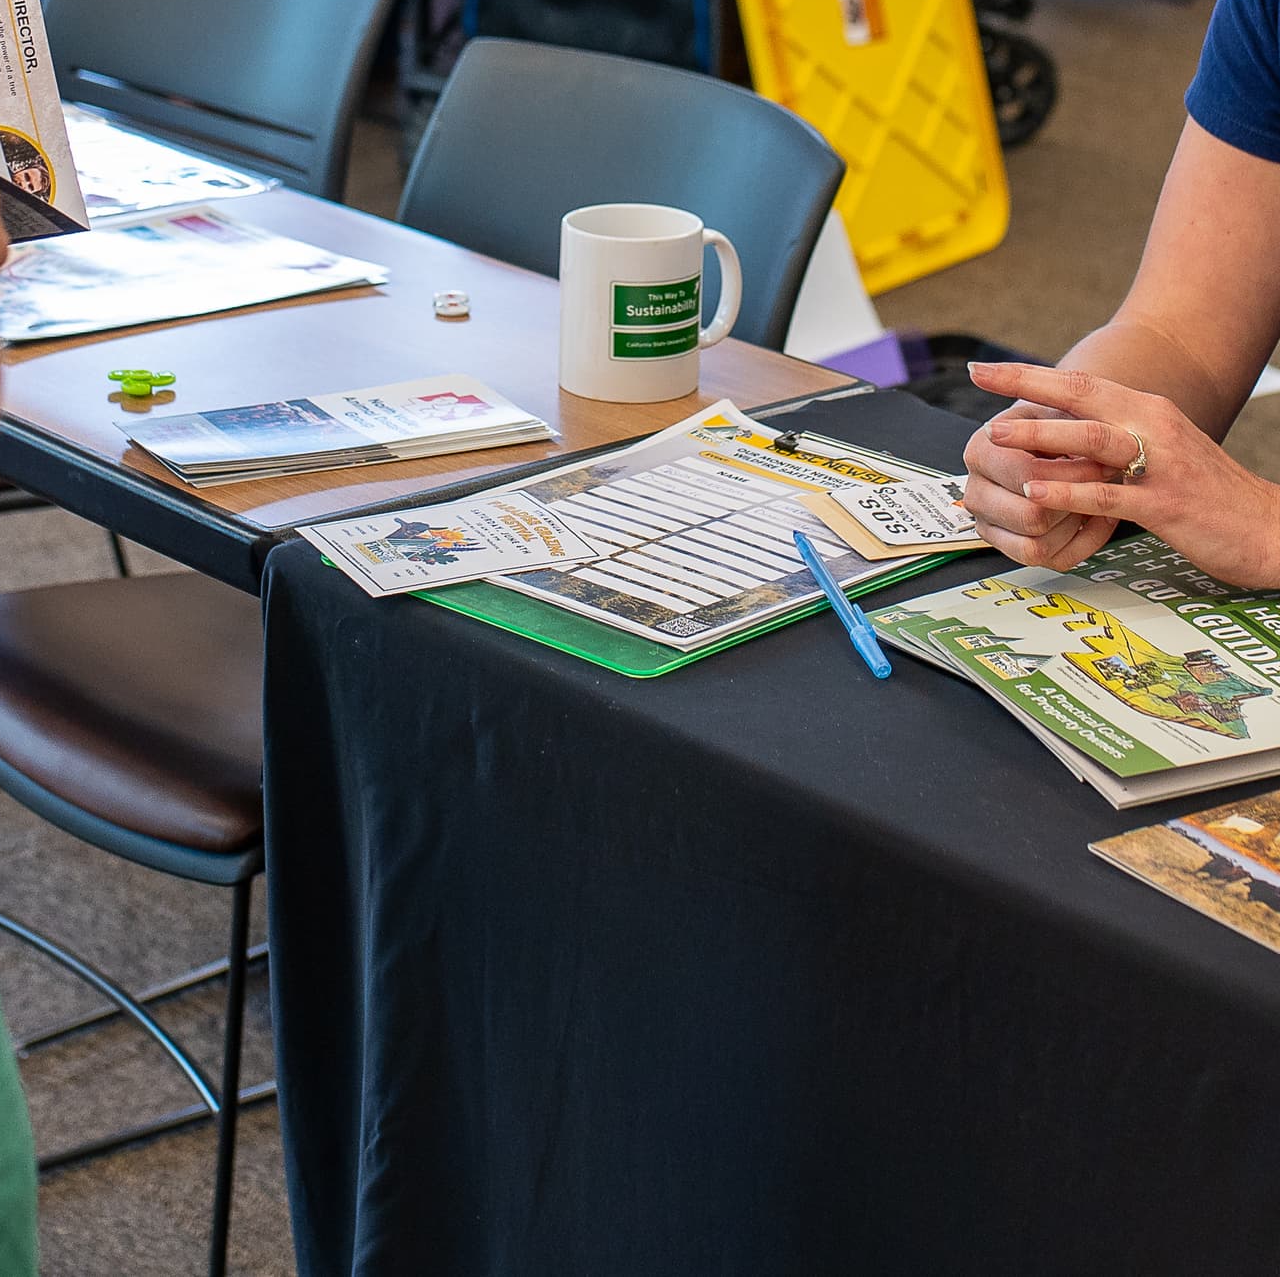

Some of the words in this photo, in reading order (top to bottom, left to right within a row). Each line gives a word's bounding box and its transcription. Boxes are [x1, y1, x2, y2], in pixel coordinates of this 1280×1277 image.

[626, 298, 696, 317] Sustainability
[716, 469, 750, 482] NAME
[732, 452, 779, 470] WILDFIRE
[777, 467, 819, 482] SAFETY
[759, 454, 812, 473] MONTHLY
[531, 524, 566, 556] GRAZING
[1013, 681, 1041, 698] for
[1025, 693, 1085, 732] Property
[1038, 684, 1058, 695] A
[1048, 691, 1106, 730] Practical
[1095, 724, 1139, 751] Guide
[1075, 727, 1128, 761] Owners
